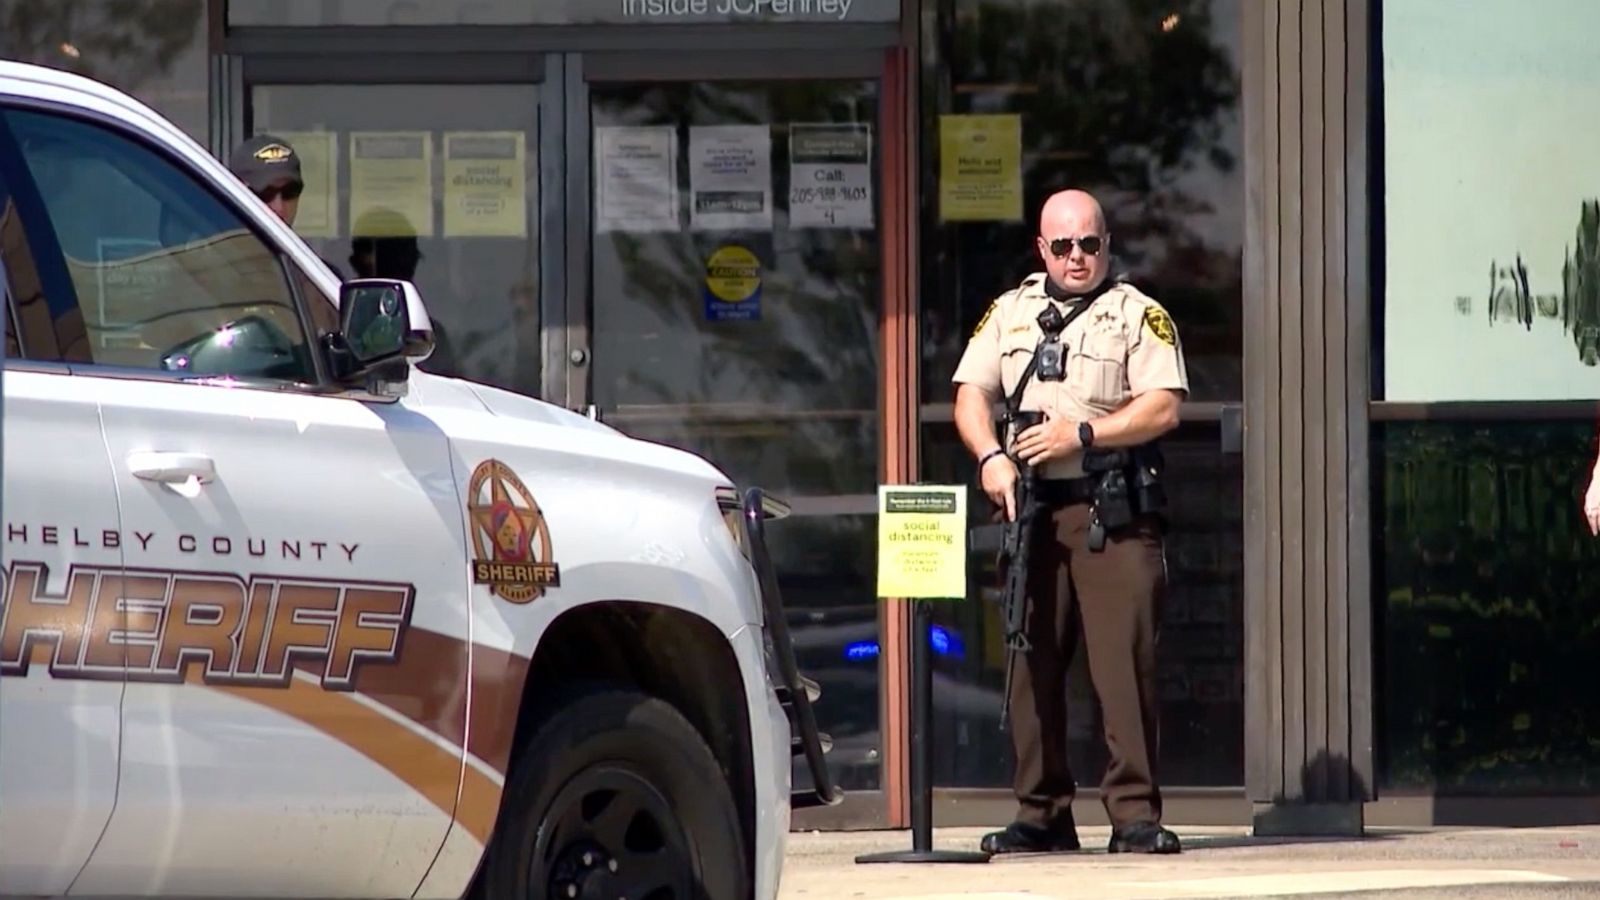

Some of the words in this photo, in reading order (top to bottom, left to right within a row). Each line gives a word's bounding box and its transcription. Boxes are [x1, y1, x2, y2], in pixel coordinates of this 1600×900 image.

[903, 520, 940, 531] social
[888, 531, 954, 545] distancing
[178, 533, 360, 562] COUNTY
[477, 564, 556, 582] SHERIFF
[0, 561, 416, 691] HERIFF
